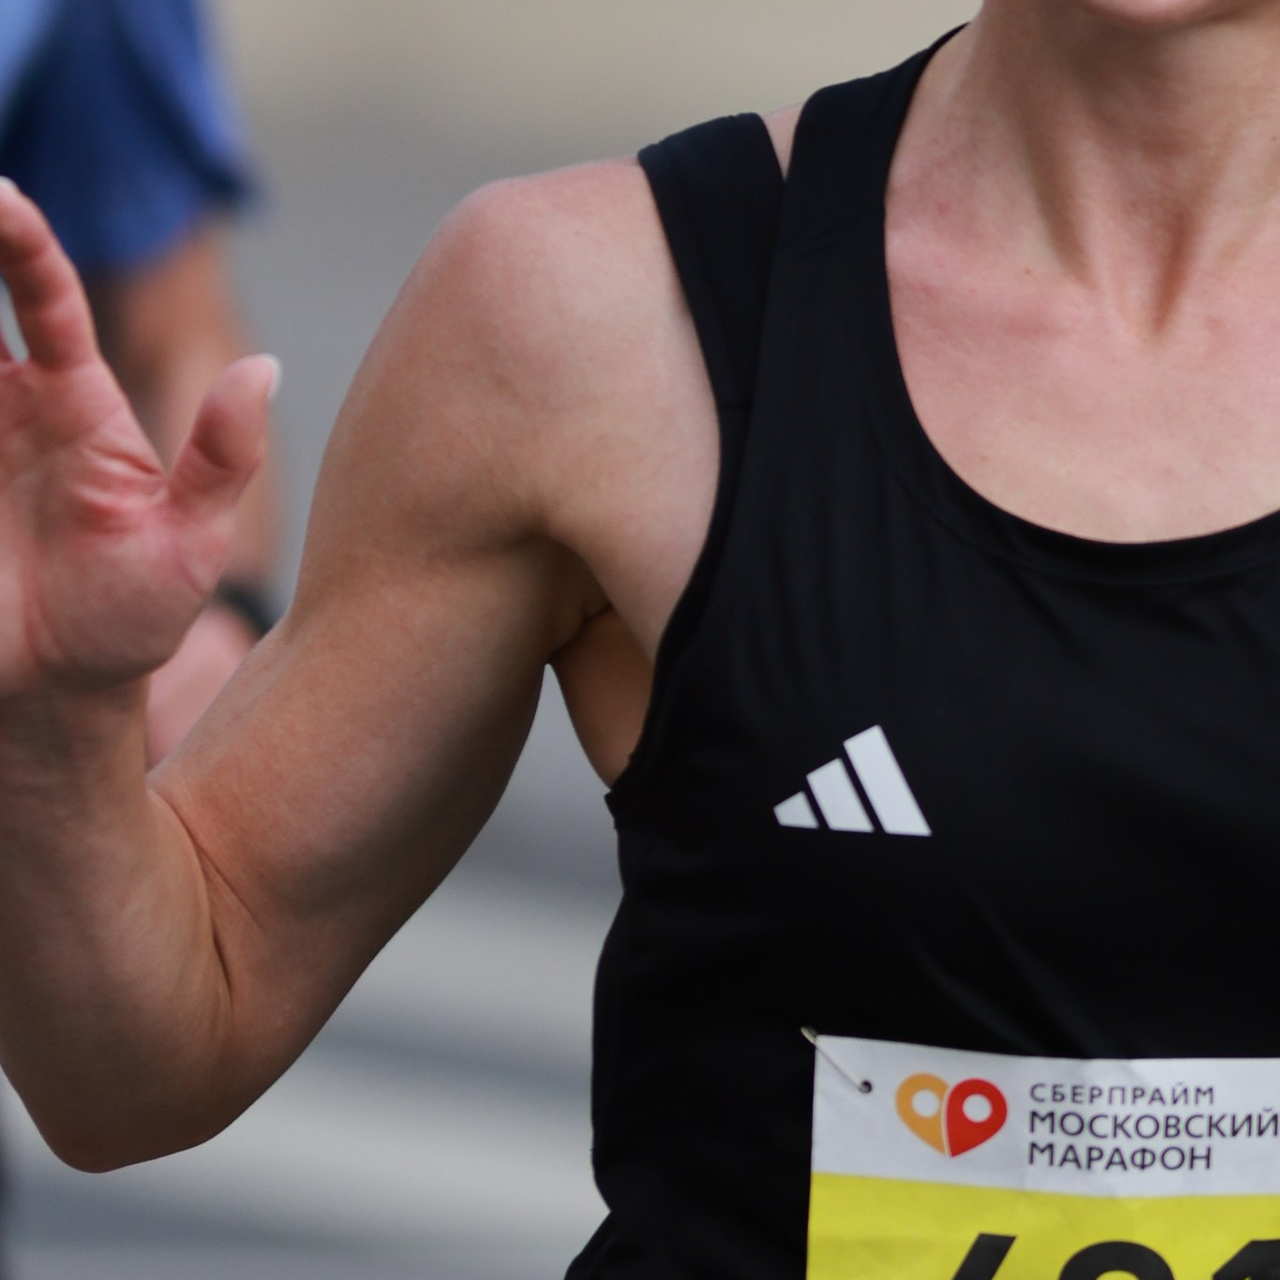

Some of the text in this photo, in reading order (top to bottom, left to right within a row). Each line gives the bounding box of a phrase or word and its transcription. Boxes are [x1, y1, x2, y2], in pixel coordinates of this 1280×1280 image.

[1029, 1081, 1214, 1106] СБЕРПРАЙМ
[1028, 1107, 1279, 1139] МОСКОВСКИЙ
[1027, 1141, 1212, 1171] МАРАФОН
